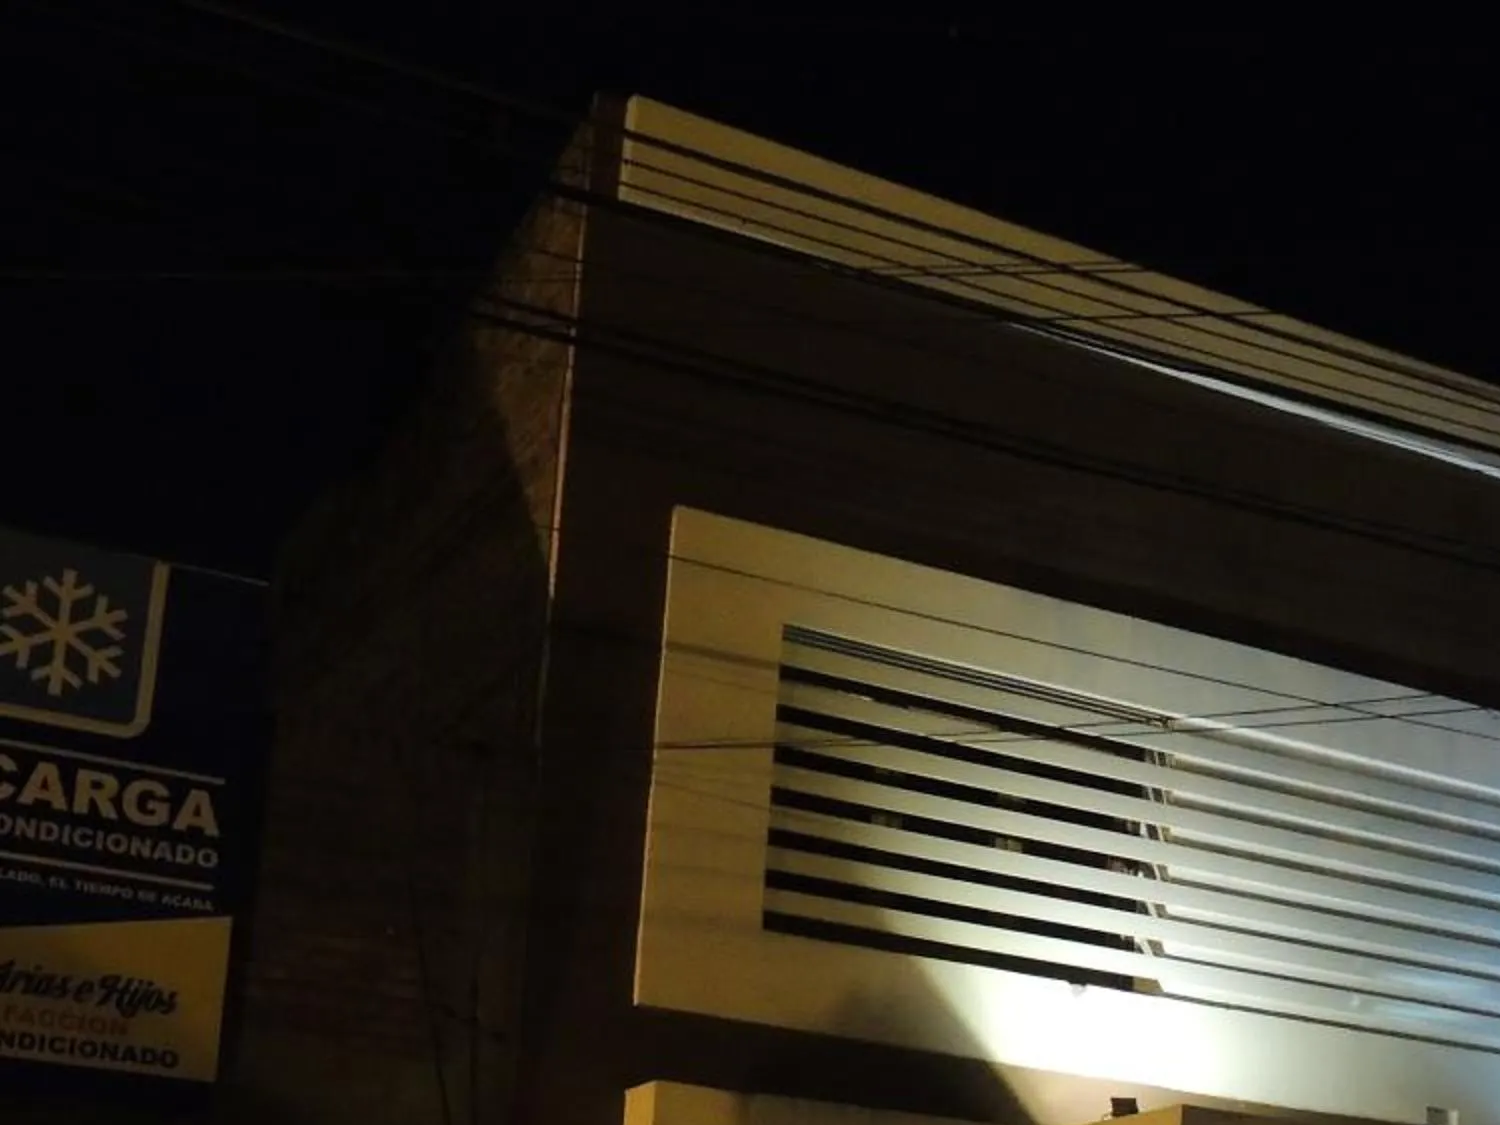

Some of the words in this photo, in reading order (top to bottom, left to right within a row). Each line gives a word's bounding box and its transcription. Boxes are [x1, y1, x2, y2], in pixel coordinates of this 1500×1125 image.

[75, 877, 134, 900] TIEMPO
[161, 893, 215, 913] ACABA
[96, 972, 178, 1019] Hijos
